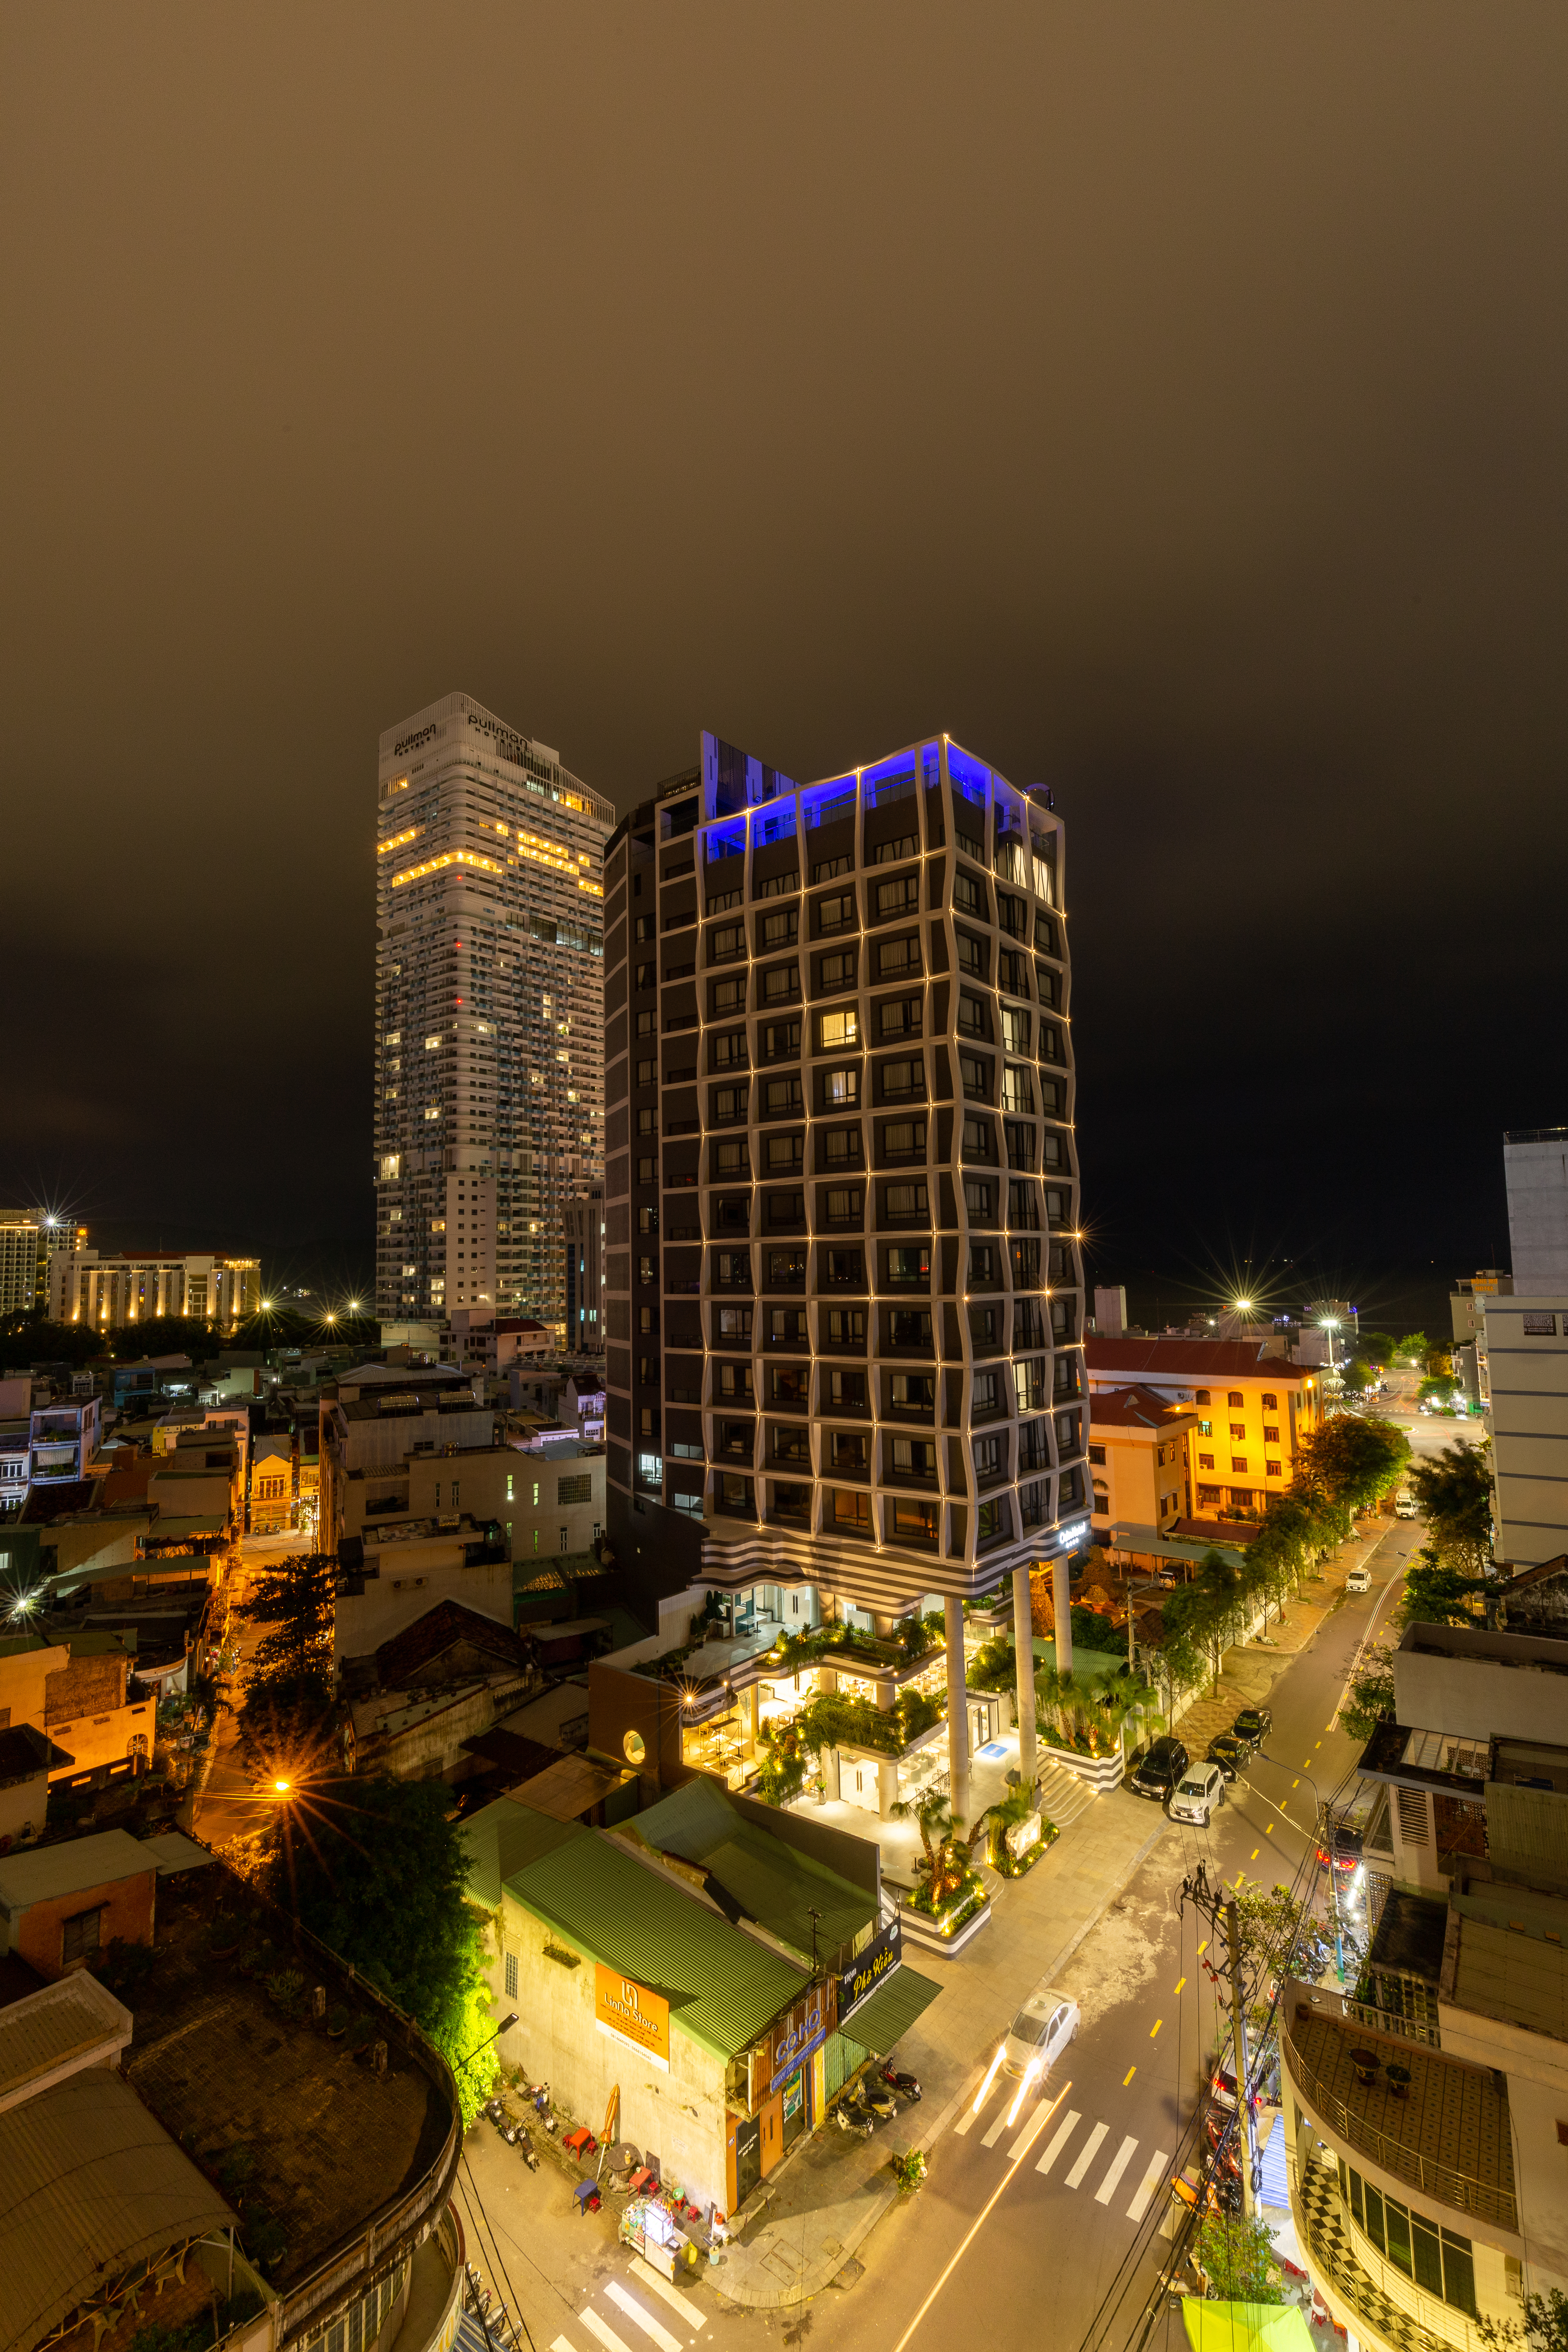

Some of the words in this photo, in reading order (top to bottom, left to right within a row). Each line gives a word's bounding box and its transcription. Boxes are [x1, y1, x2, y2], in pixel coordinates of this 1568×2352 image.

[394, 724, 436, 756] pullman
[399, 736, 430, 757] HOTELS
[469, 715, 527, 751] pullman
[475, 727, 520, 751] HOTELS
[844, 1967, 857, 1985] Tiệm
[854, 1969, 871, 2001] Phở
[873, 1946, 894, 1977] Kiều
[633, 2009, 658, 2032] Store
[773, 2069, 786, 2089] BERRY
[797, 2044, 811, 2063] COFFEE
